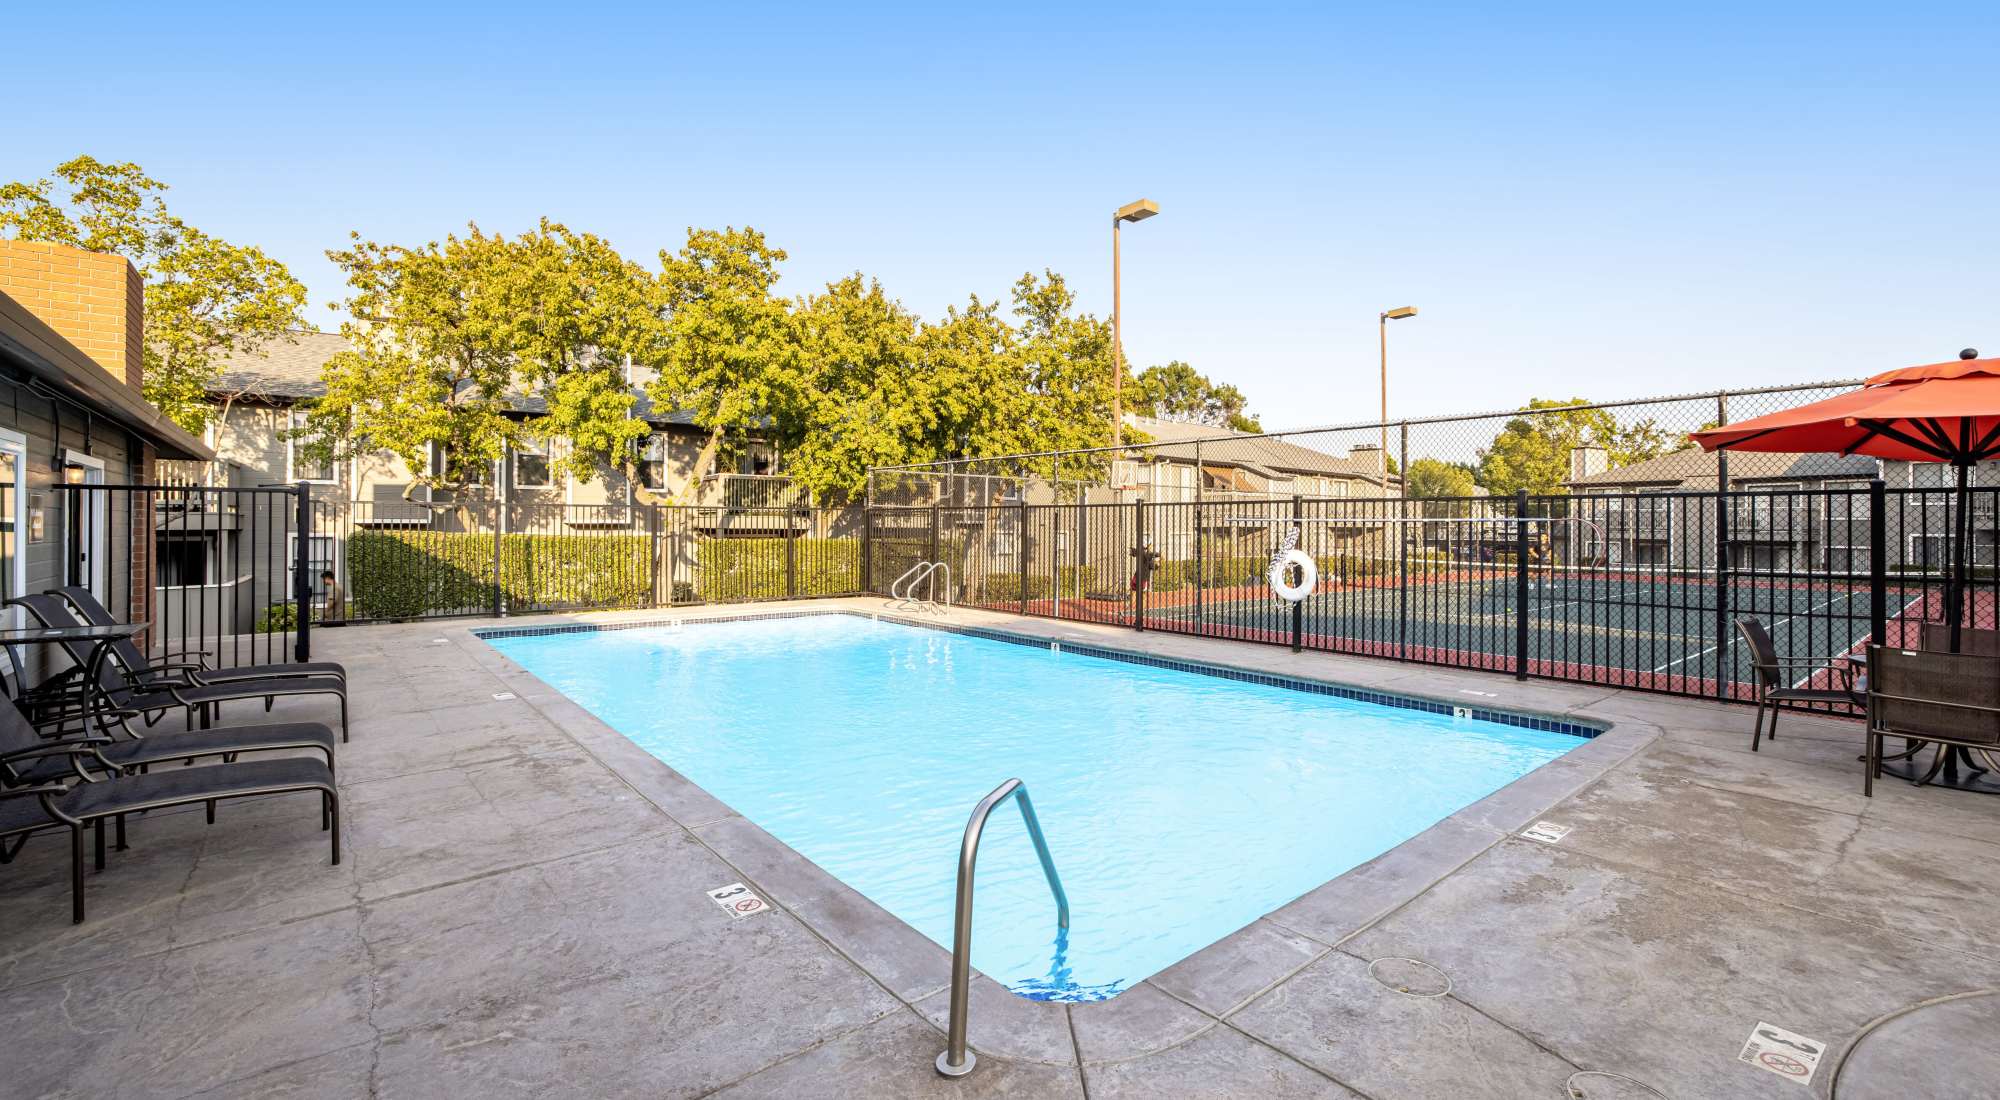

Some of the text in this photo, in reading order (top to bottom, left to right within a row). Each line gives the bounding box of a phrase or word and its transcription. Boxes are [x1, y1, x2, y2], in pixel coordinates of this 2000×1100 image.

[1526, 830, 1558, 840] 3
[714, 887, 746, 899] 3
[1758, 1029, 1819, 1054] 3
